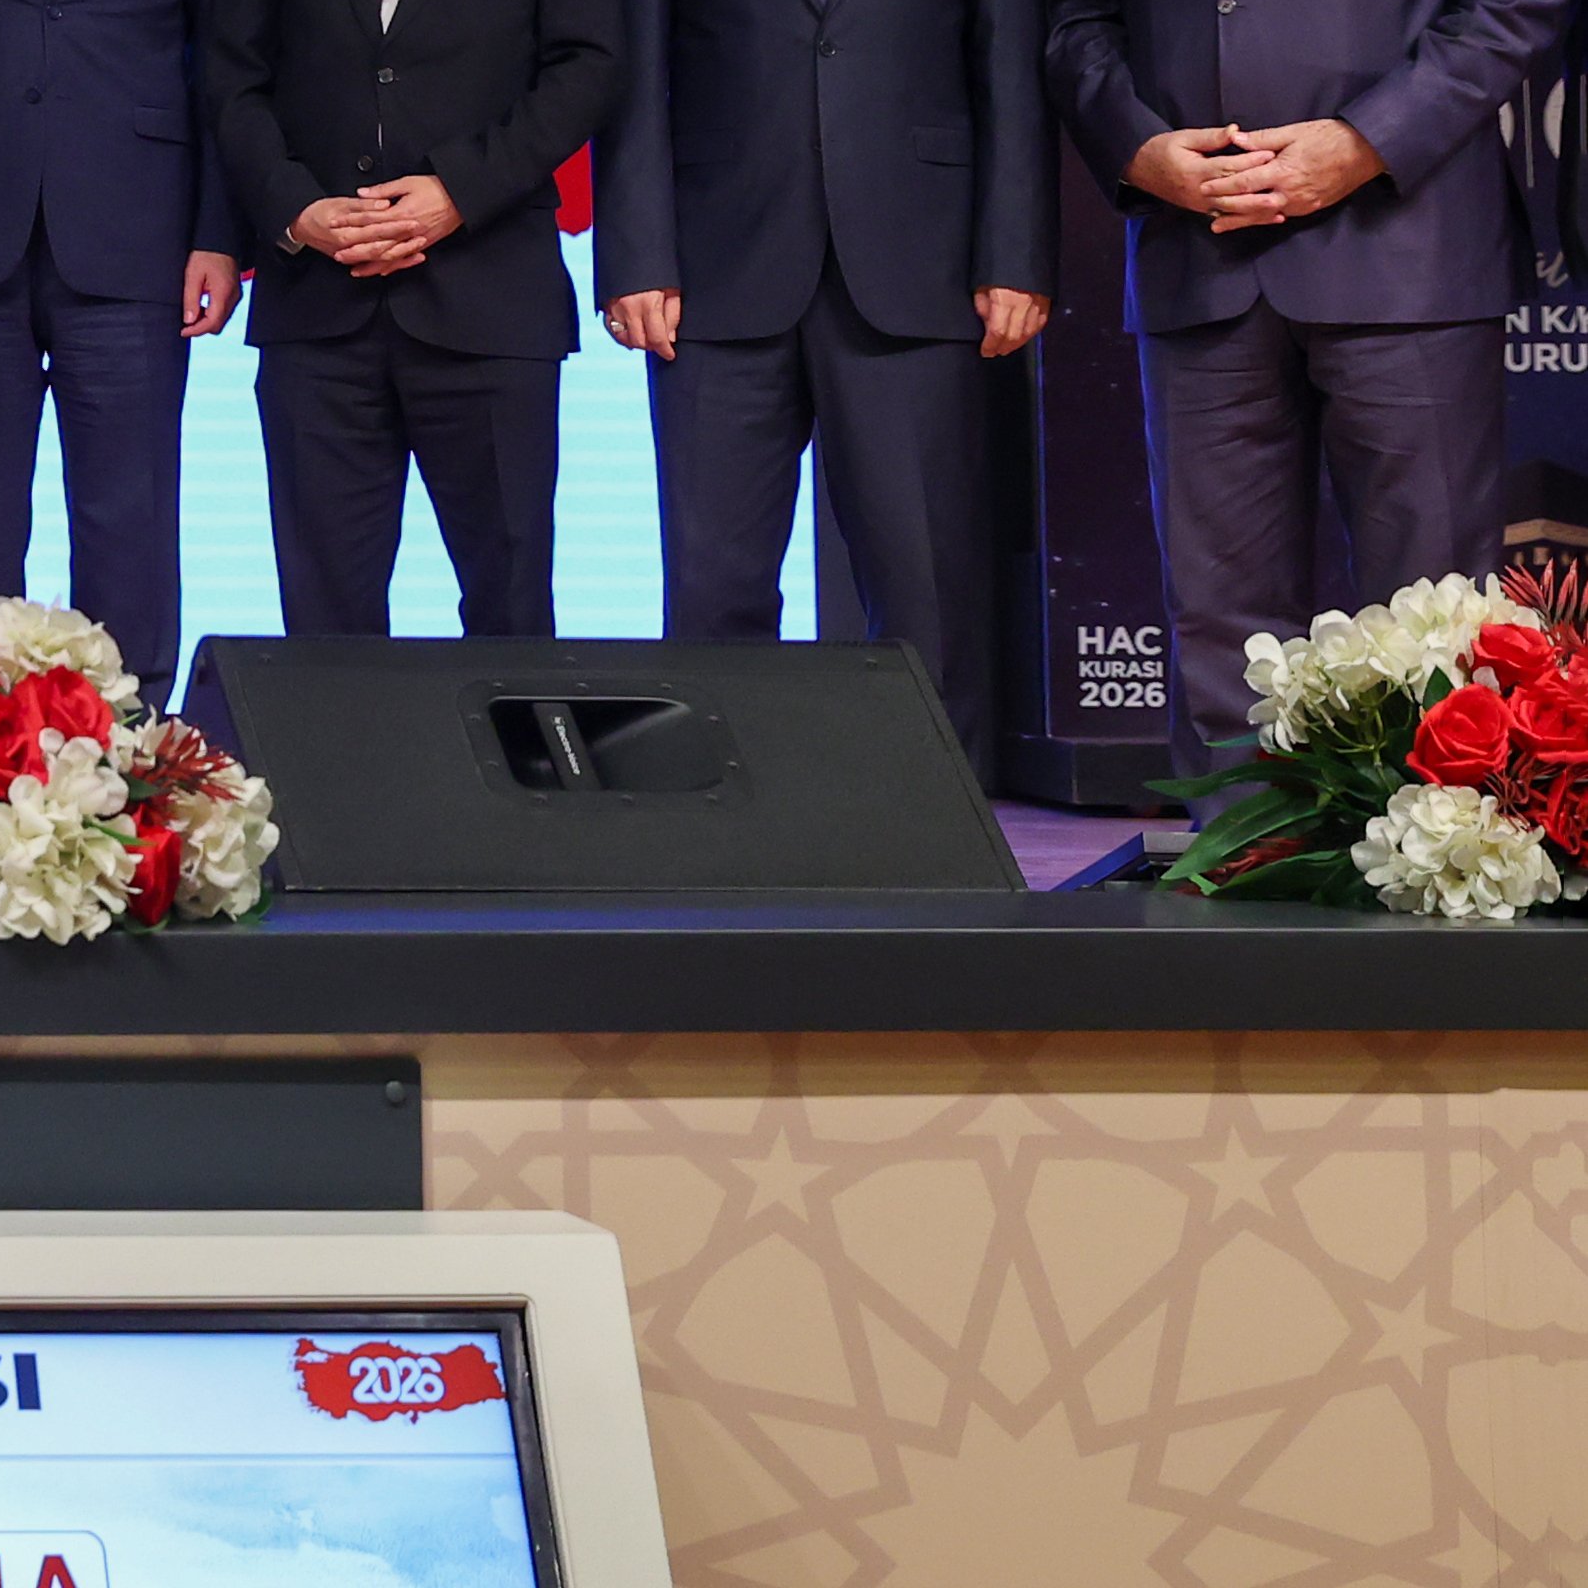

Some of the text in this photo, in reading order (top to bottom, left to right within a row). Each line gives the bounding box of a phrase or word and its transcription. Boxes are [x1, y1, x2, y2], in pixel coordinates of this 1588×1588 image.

[1077, 625, 1164, 656] HAC
[1078, 660, 1164, 678] KURASI
[1078, 681, 1167, 708] 2026
[348, 1355, 445, 1404] 2026
